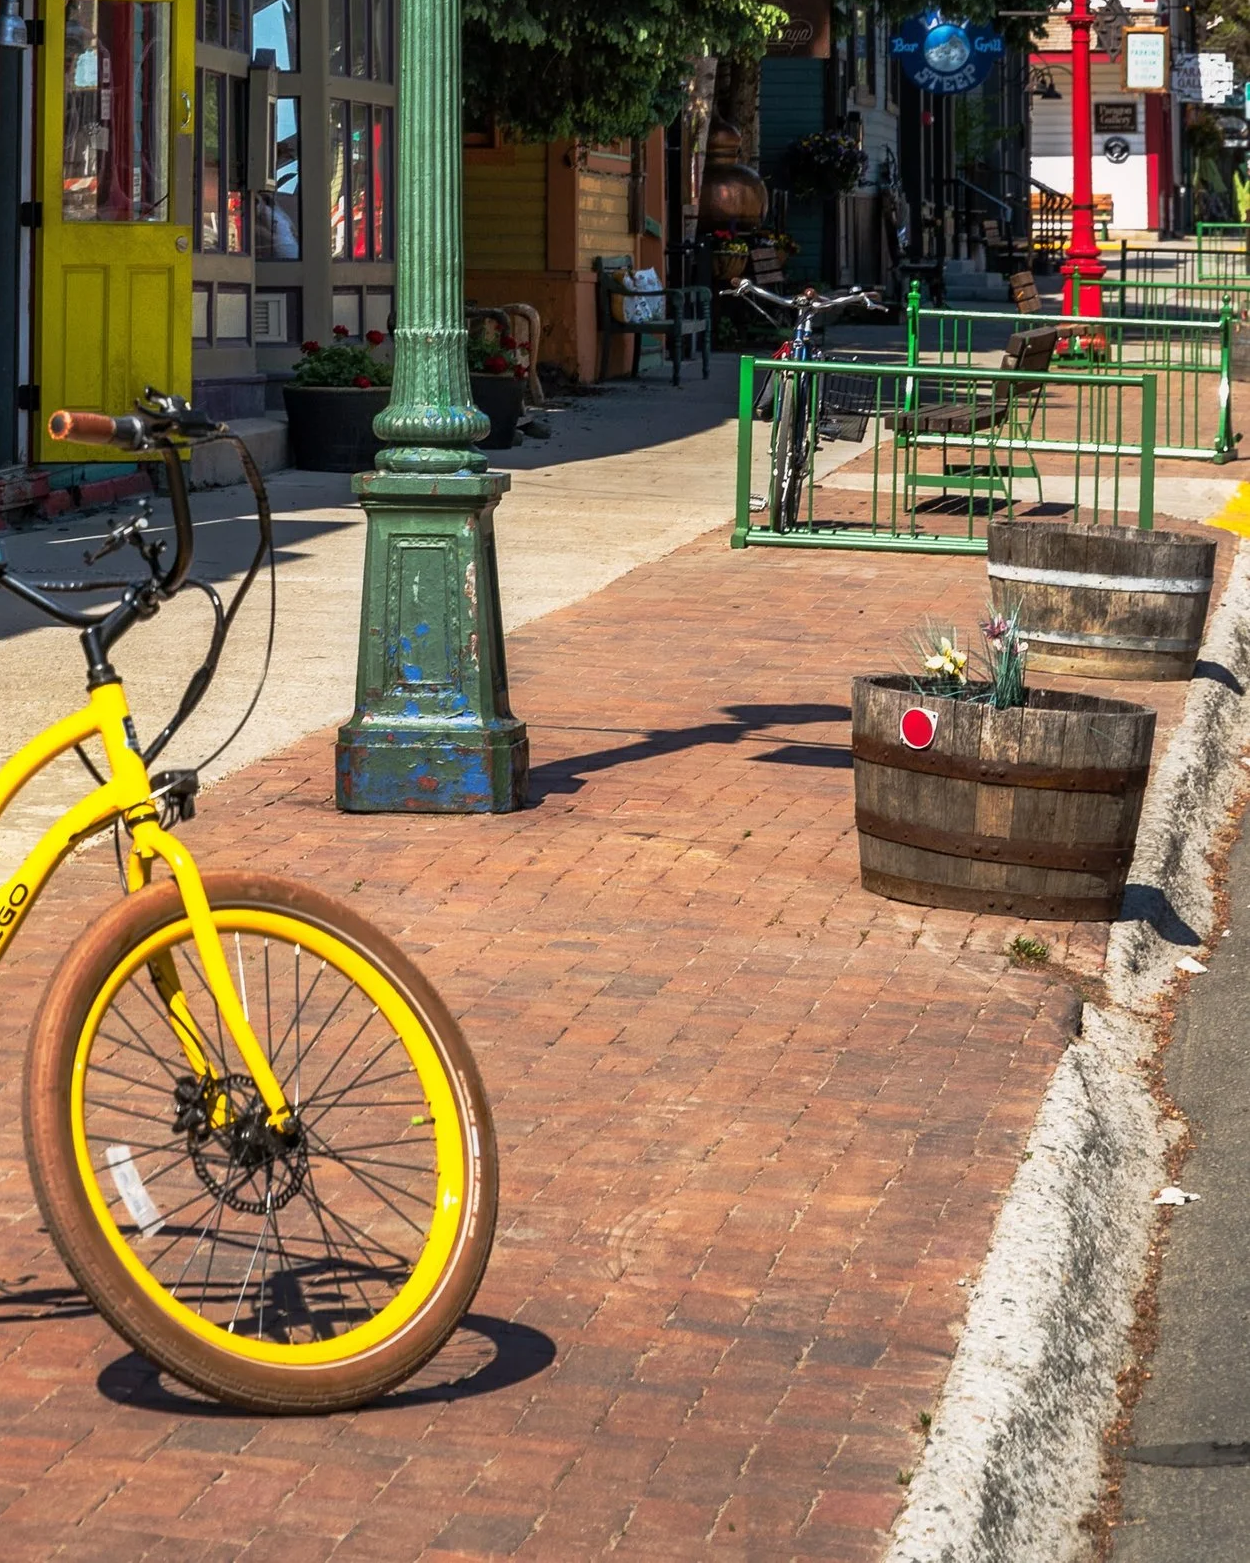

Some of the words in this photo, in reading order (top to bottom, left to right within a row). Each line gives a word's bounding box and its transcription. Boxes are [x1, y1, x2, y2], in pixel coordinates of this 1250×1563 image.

[893, 39, 919, 52] Bar
[975, 40, 1002, 53] Grill
[915, 63, 978, 92] STEEP
